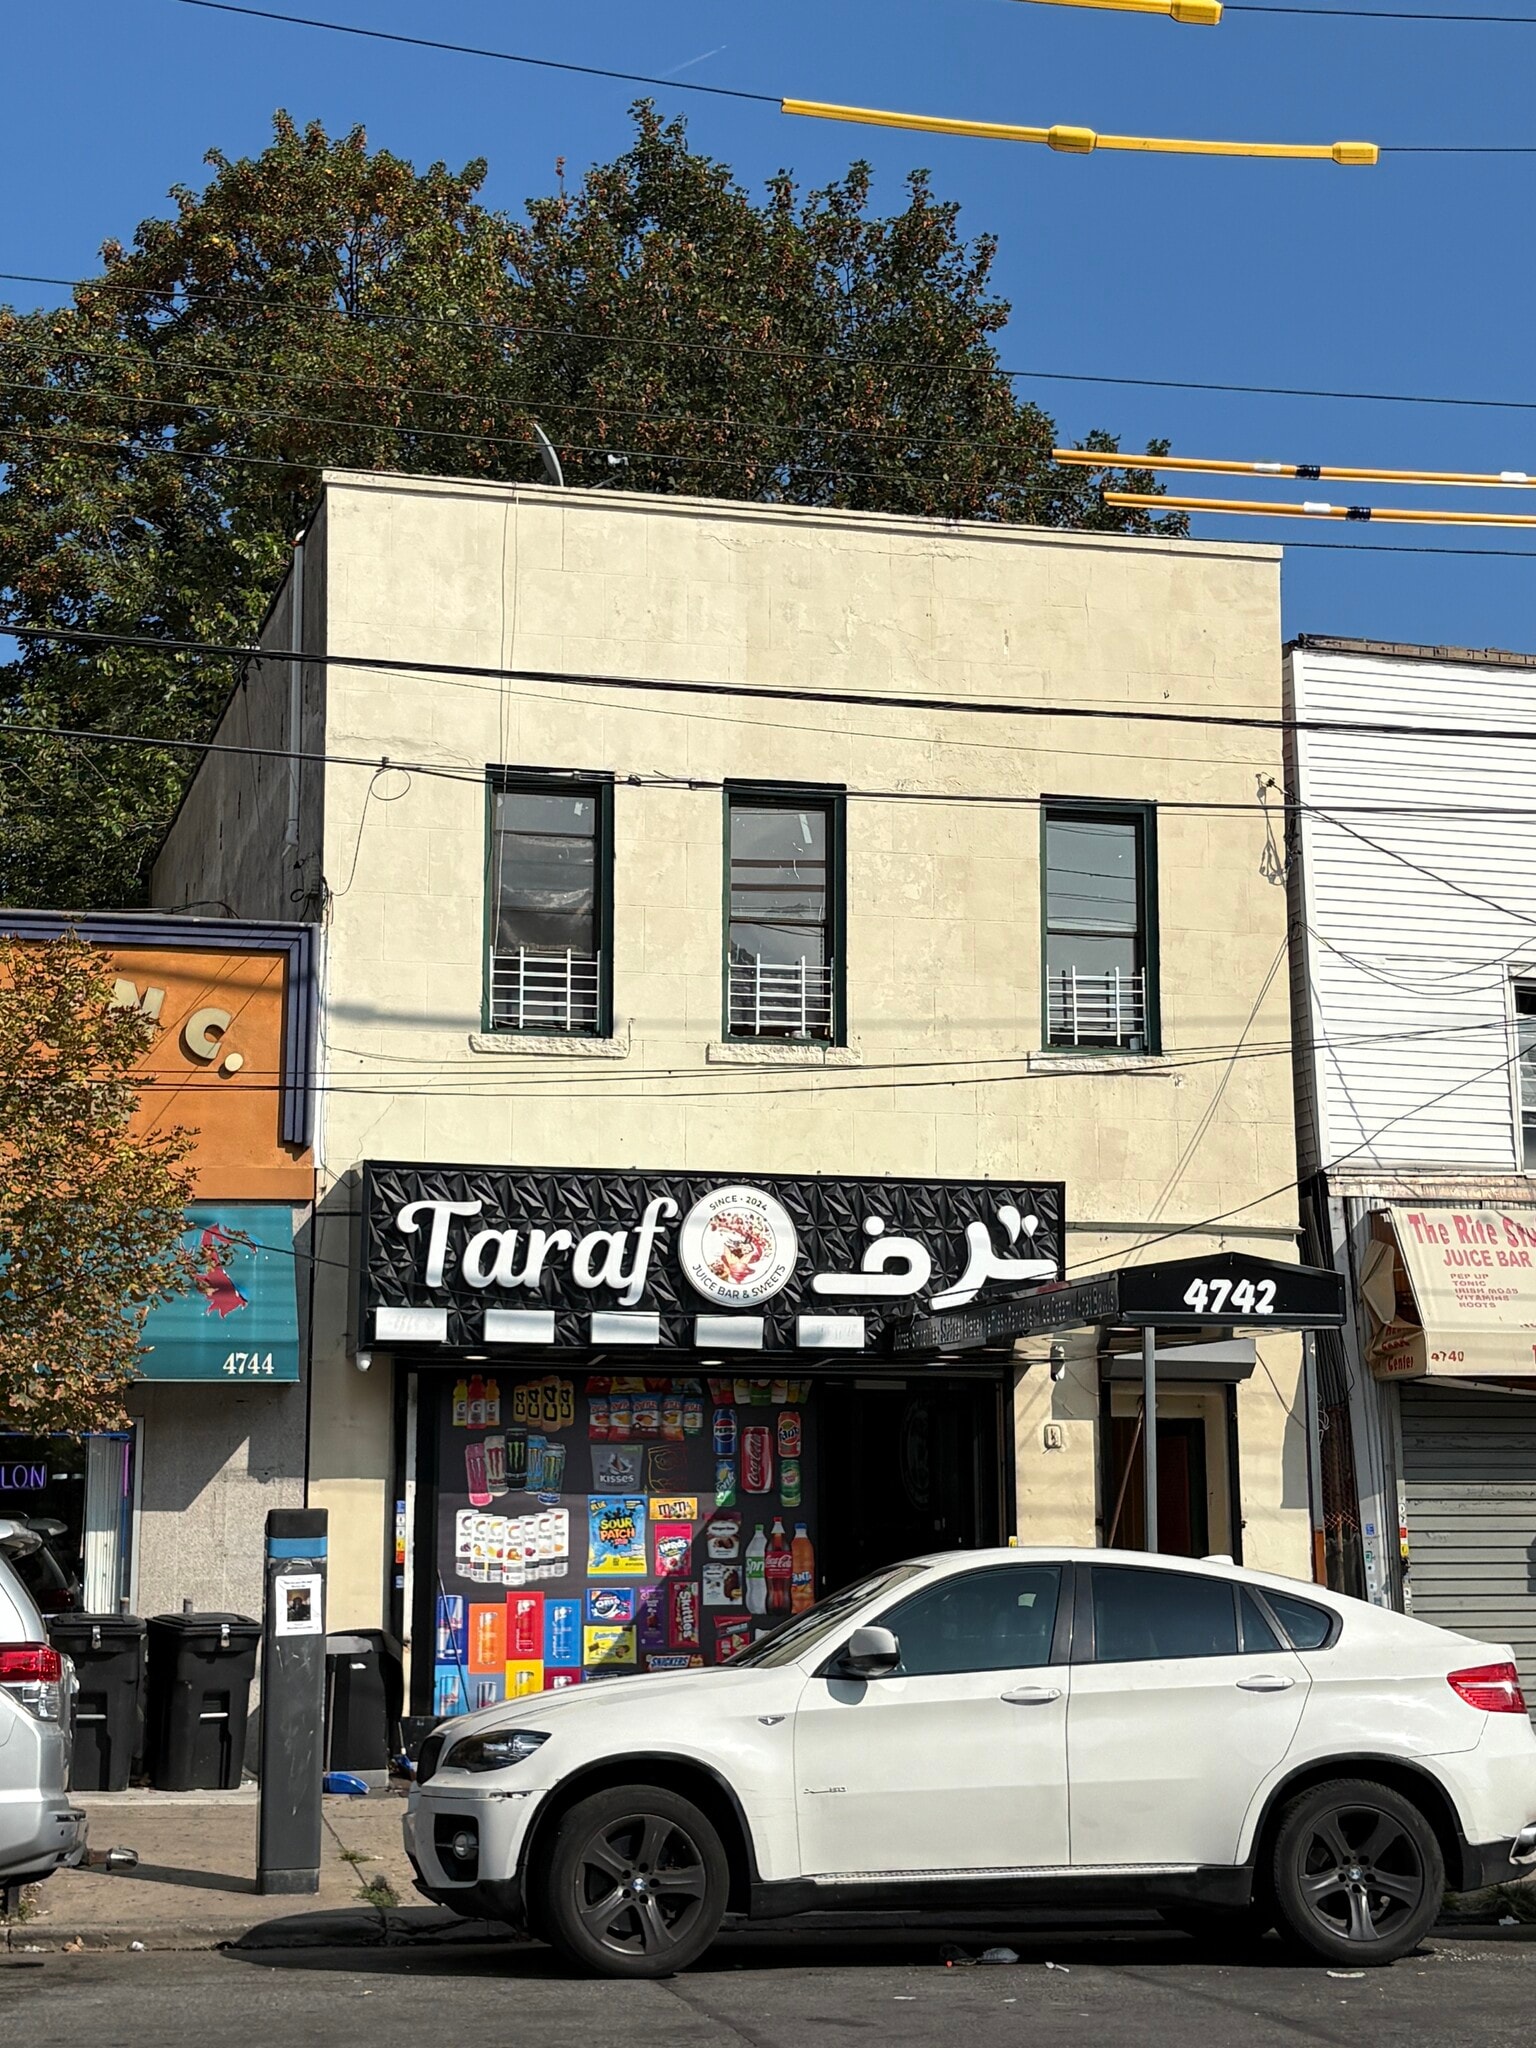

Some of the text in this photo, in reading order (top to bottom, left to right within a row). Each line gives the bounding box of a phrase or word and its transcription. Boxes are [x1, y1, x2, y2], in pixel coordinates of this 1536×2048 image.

[709, 1195, 768, 1211] SINCE 2024
[1407, 1212, 1536, 1248] The Rite Stu
[396, 1196, 679, 1306] Taraf
[1443, 1249, 1533, 1268] JUICE BAR
[692, 1264, 786, 1299] JUICE BAR & SWEETS
[1183, 1278, 1277, 1315] 4742
[222, 1352, 275, 1375] 4744
[543, 1384, 558, 1422] C4
[1, 1464, 45, 1488] LON
[600, 1474, 634, 1483] KISSES
[600, 1517, 632, 1530] SOUR
[600, 1528, 635, 1540] PATCH
